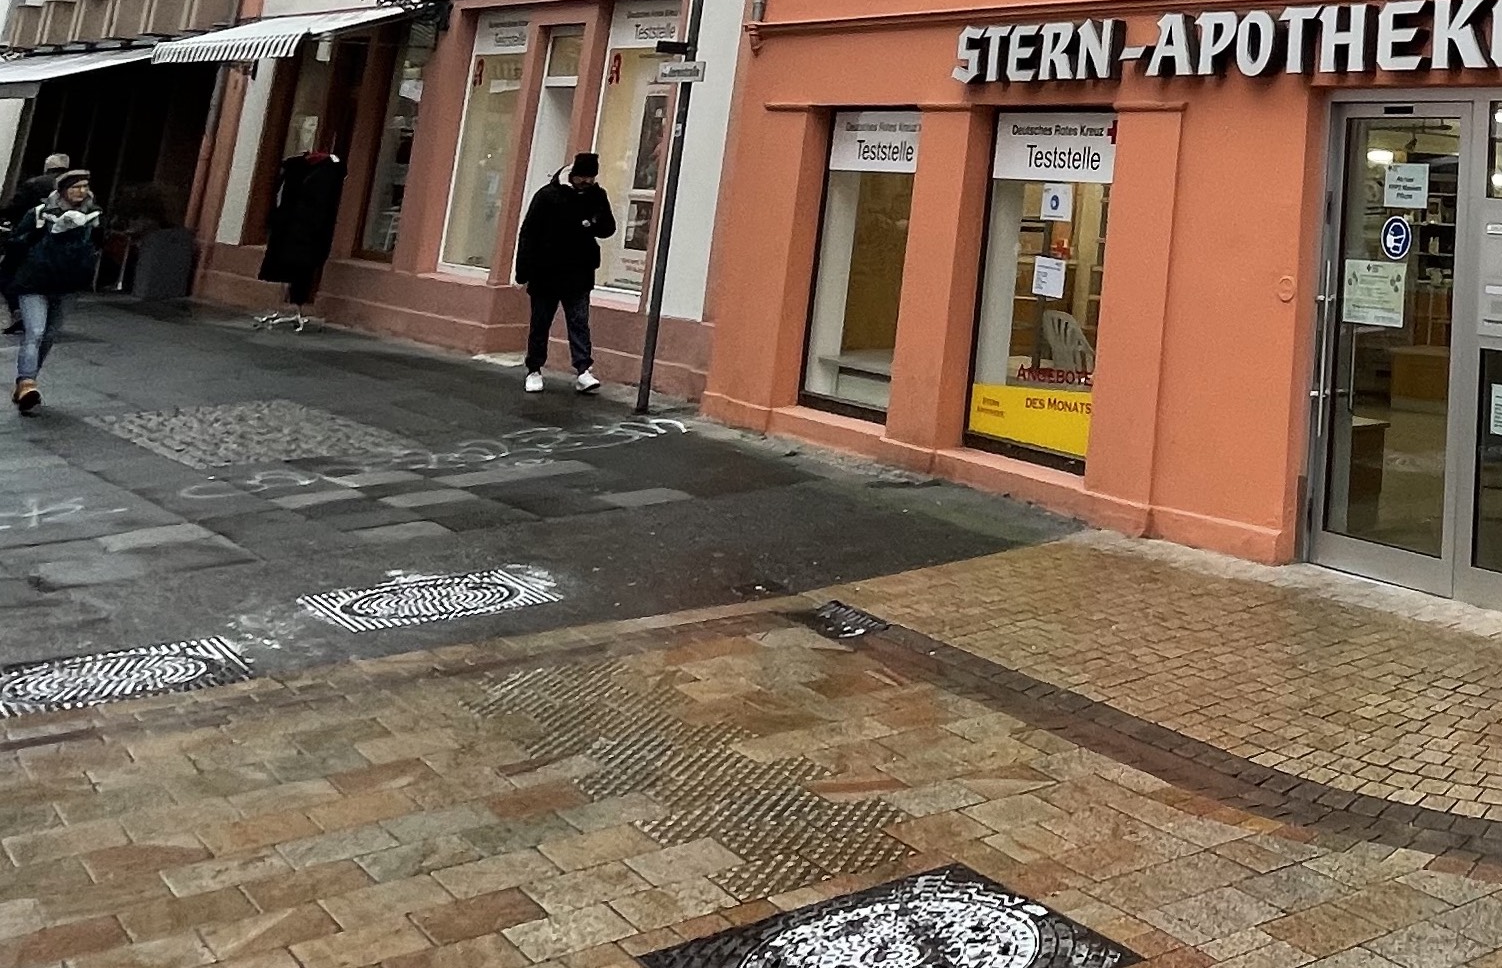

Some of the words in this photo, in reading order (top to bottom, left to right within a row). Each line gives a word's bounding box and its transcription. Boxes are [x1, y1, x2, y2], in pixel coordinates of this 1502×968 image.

[1012, 124, 1053, 137] Deutsches
[1054, 125, 1077, 137] Rotes
[1079, 125, 1104, 138] Kreuz
[857, 139, 914, 162] Teststelle
[1026, 144, 1101, 171] Teststelle
[1016, 363, 1093, 387] ANGEBOTE
[1025, 397, 1046, 410] DES
[1047, 397, 1092, 415] MONATS
